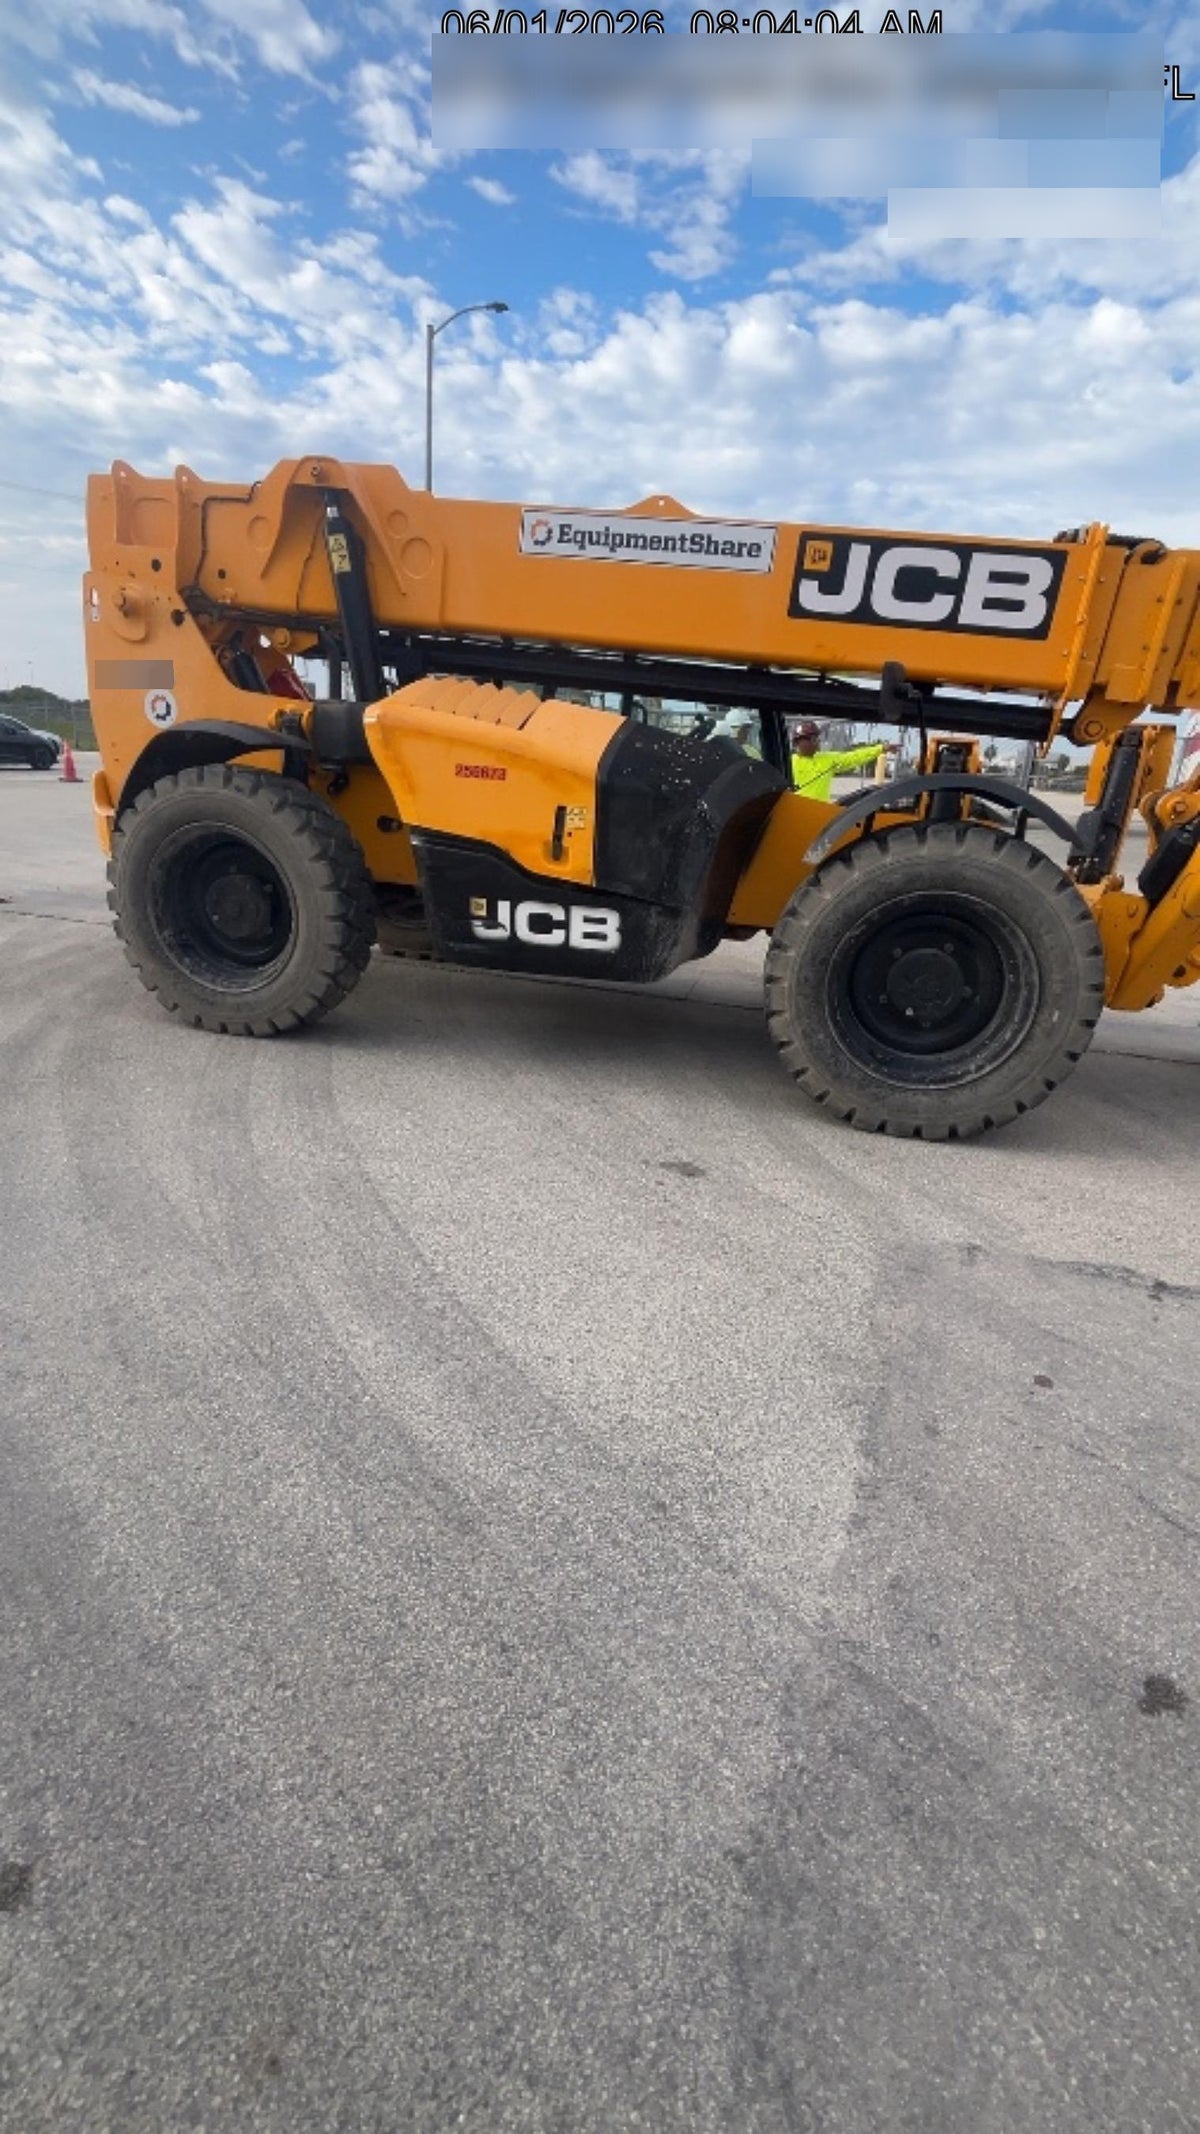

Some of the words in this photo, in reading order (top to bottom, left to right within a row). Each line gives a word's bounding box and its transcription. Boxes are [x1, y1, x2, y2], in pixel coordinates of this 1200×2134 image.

[557, 523, 762, 558] EquipmentShare
[798, 542, 1054, 629] JCB
[471, 900, 622, 950] JCB
